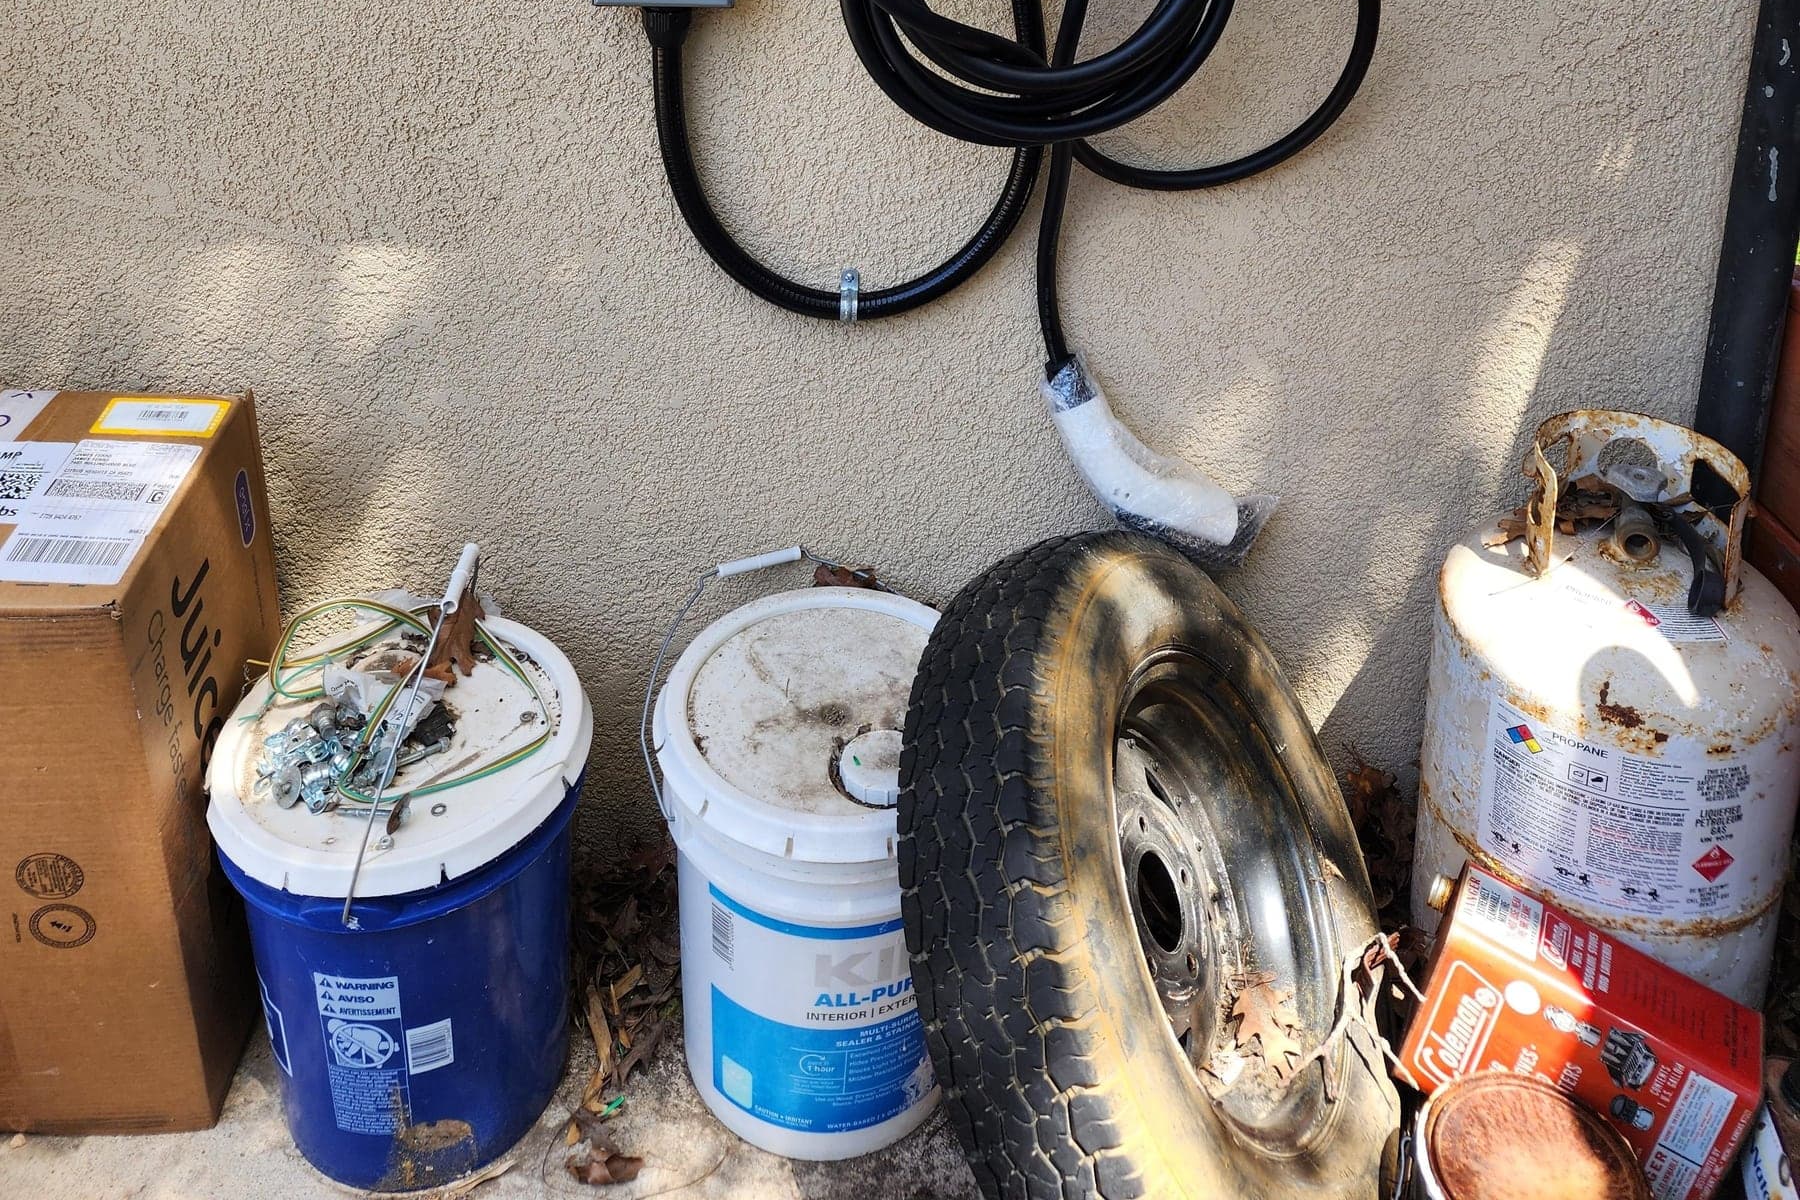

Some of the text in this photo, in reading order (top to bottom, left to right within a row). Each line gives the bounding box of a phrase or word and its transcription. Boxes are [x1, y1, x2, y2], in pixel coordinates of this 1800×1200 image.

[147, 608, 174, 727] Charge
[1552, 731, 1609, 760] PROPANE
[1494, 746, 1521, 768] DANGER
[1700, 805, 1741, 818] LIQUEFIED
[1695, 813, 1743, 827] PETROLEUM
[1710, 825, 1727, 835] GAS
[1463, 876, 1481, 916] DANGER
[1574, 935, 1585, 951] FOR
[1582, 931, 1599, 990] GASOLINE STOVES
[1598, 941, 1613, 994] AND LANTERNS
[335, 980, 395, 990] WARNING
[338, 995, 375, 1003] AVISO
[339, 1006, 396, 1016] AVERTISSEMENT
[807, 1010, 867, 1021] INTERIOR
[836, 1037, 872, 1047] SEALER
[1649, 1064, 1671, 1097] CONTENTS
[1667, 1062, 1686, 1089] GALLON
[754, 1104, 779, 1118] CAUTION
